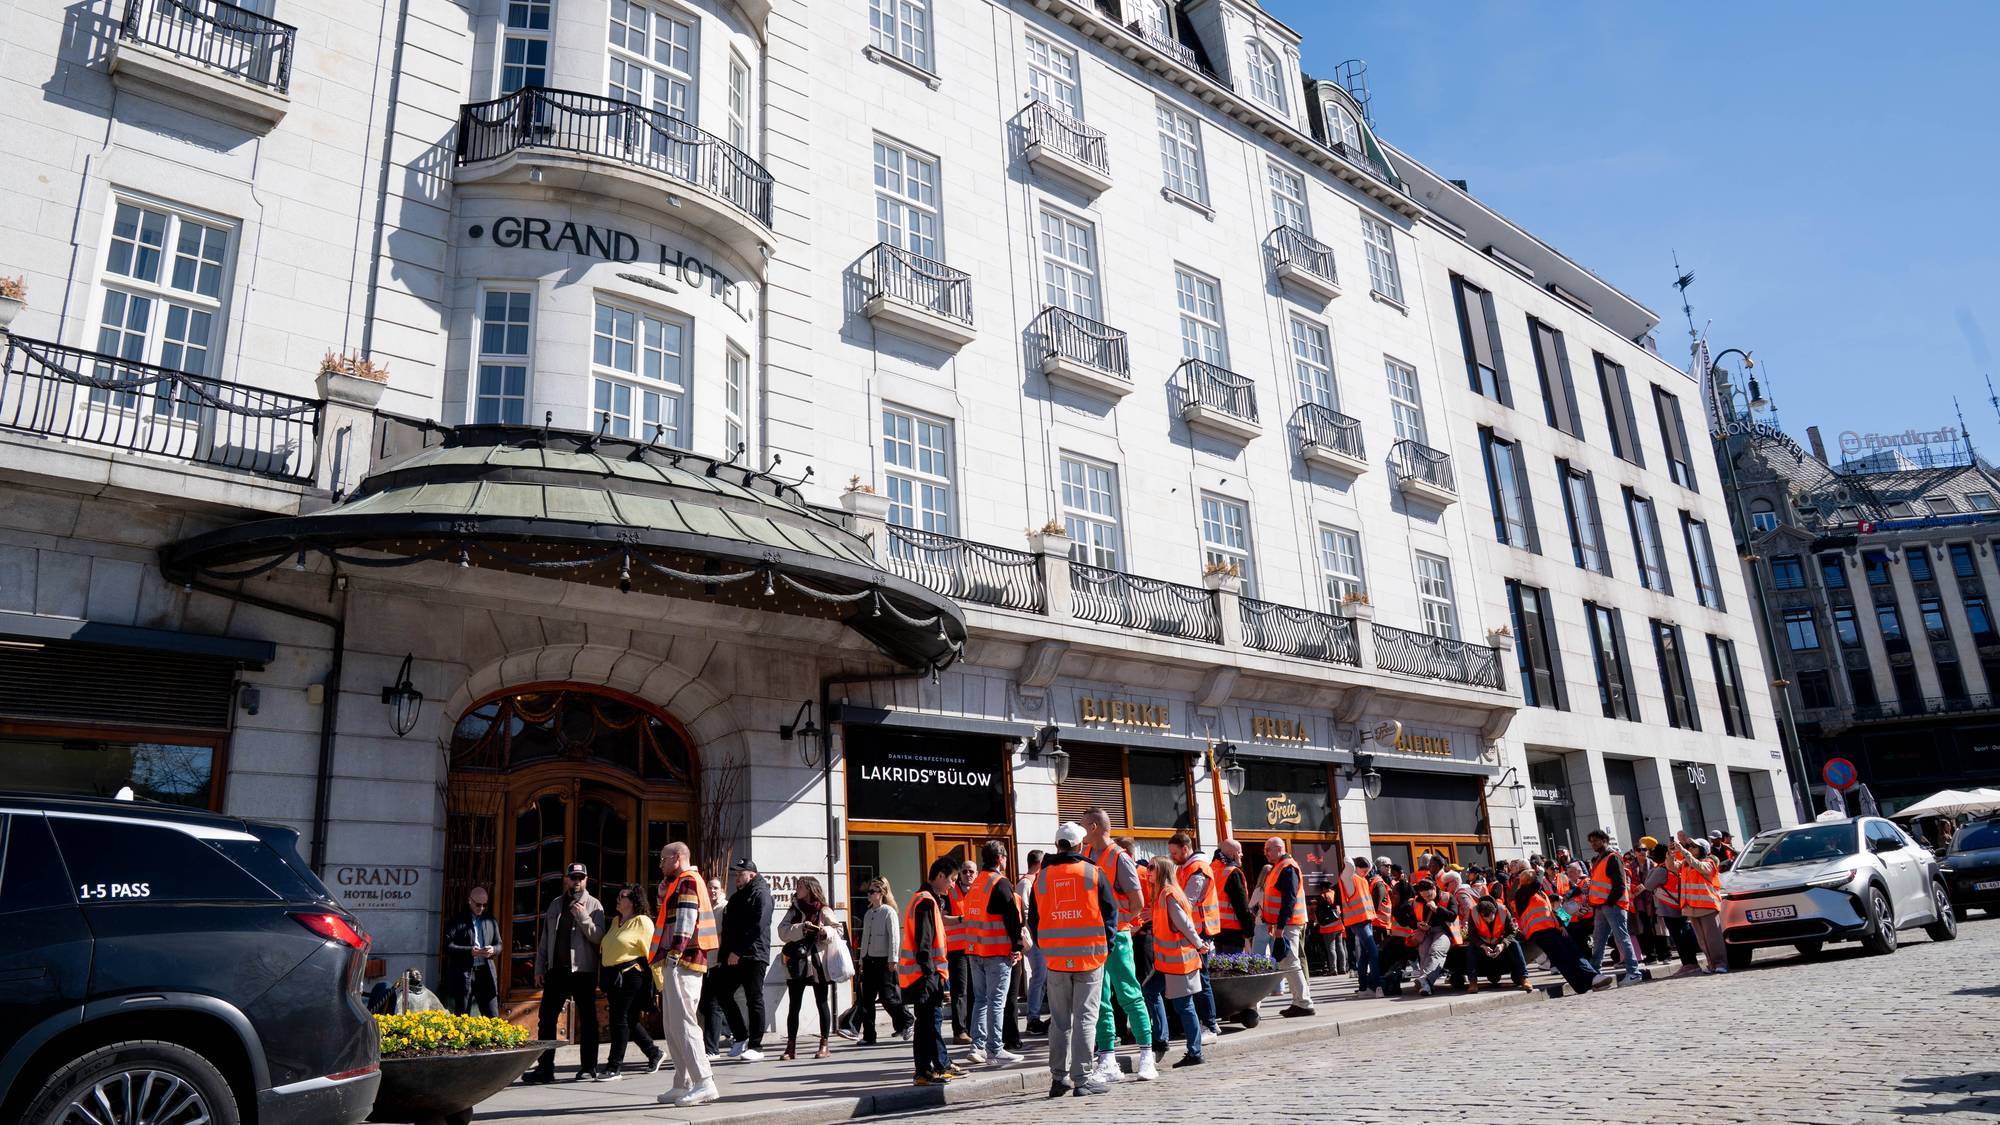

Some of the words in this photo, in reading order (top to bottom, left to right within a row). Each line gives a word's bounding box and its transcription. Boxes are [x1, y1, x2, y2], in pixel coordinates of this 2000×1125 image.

[492, 216, 640, 264] GRAND
[659, 244, 748, 323] HOTEL
[1080, 696, 1171, 729] BJERKE
[1252, 716, 1311, 742] FREIA
[915, 755, 966, 764] CONFECTIONERY
[861, 765, 929, 783] LAKRIDS
[937, 768, 992, 787] BÜLOW
[1687, 762, 1707, 790] DNB
[1531, 785, 1549, 798] ohans
[1266, 792, 1302, 826] Freia
[337, 867, 420, 886] GRAND
[80, 883, 107, 899] 1-5
[111, 882, 151, 898] PASS
[343, 890, 378, 900] HOTEL
[384, 890, 412, 900] OSLO
[1051, 910, 1082, 920] STREIK
[1766, 907, 1792, 918] 67513
